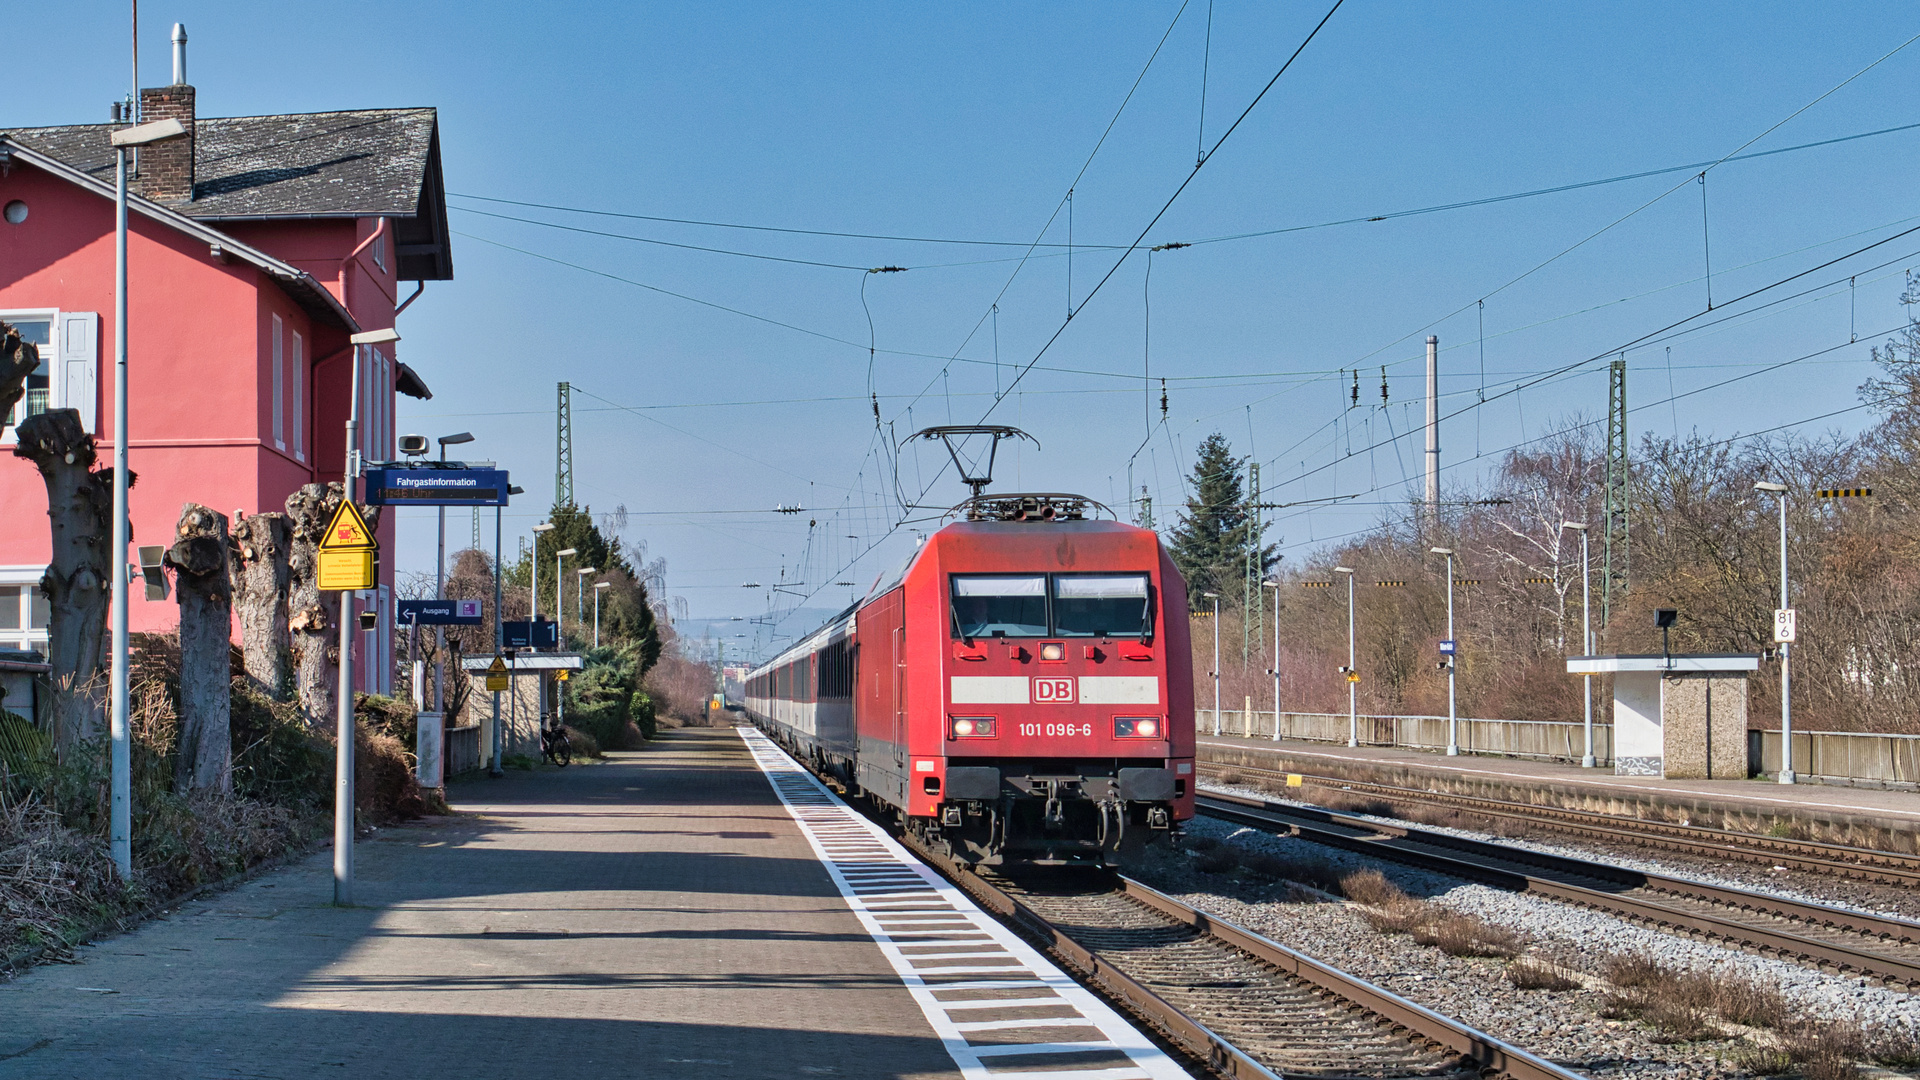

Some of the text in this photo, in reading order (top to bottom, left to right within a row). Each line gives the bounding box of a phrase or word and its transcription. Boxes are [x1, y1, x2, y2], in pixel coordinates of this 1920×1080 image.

[396, 477, 477, 488] Fahrgastinformation
[412, 488, 435, 498] Uhr
[422, 607, 450, 616] Ausgang
[1778, 612, 1792, 624] 81
[547, 623, 556, 642] 1
[1780, 626, 1790, 638] 6
[1038, 681, 1070, 699] DB
[1019, 723, 1092, 737] 101 096-6
